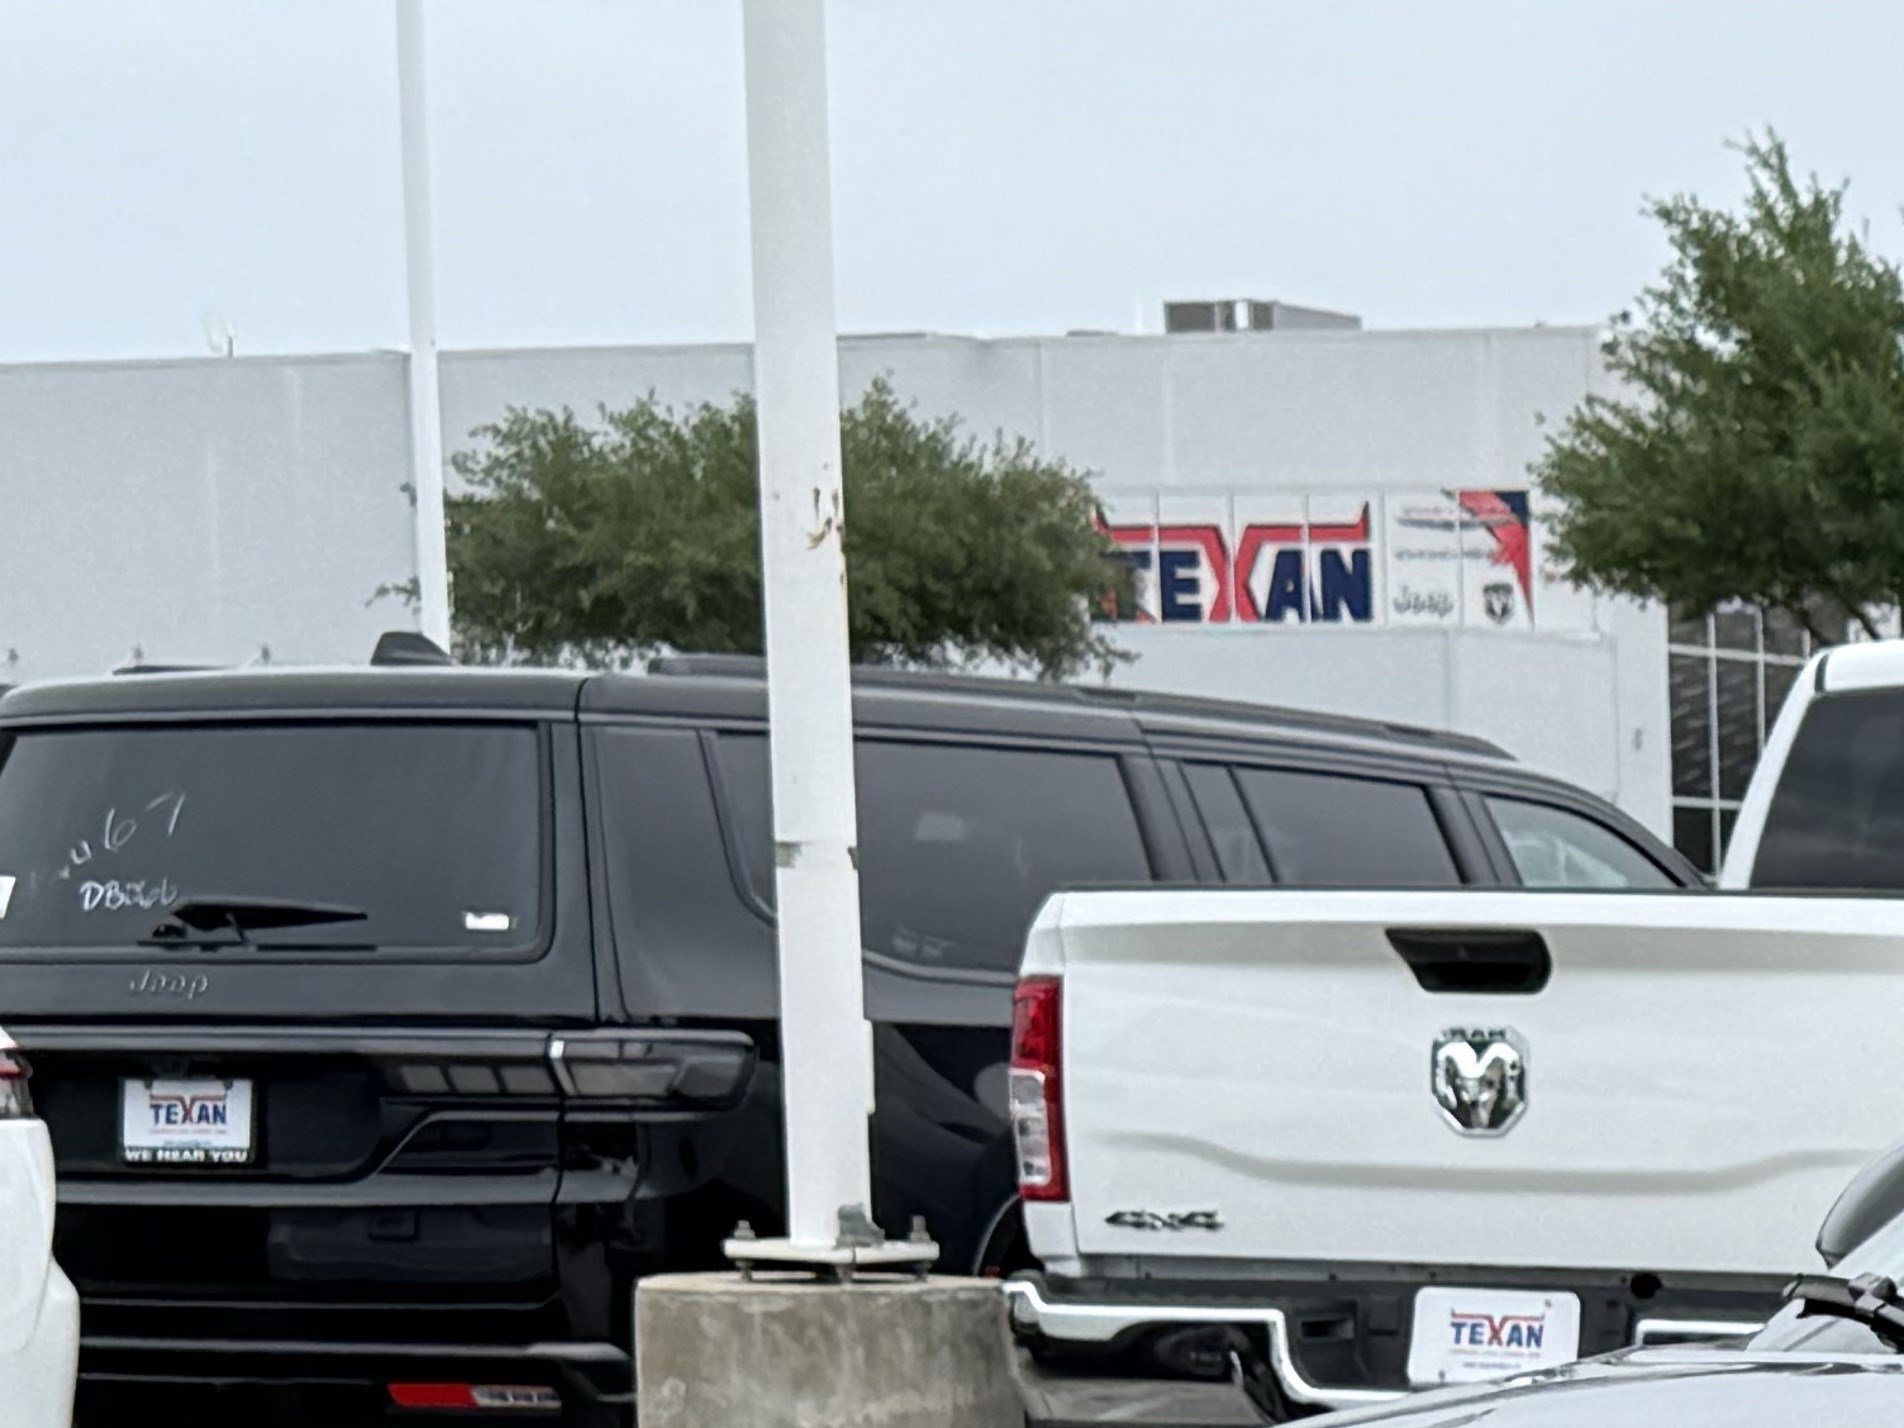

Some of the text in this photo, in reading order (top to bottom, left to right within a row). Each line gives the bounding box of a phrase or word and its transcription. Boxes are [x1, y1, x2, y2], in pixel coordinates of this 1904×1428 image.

[149, 1093, 228, 1125] TEXAN
[124, 1148, 152, 1162] WE
[209, 1148, 249, 1162] YOU
[1450, 1308, 1545, 1348] TEXAN
